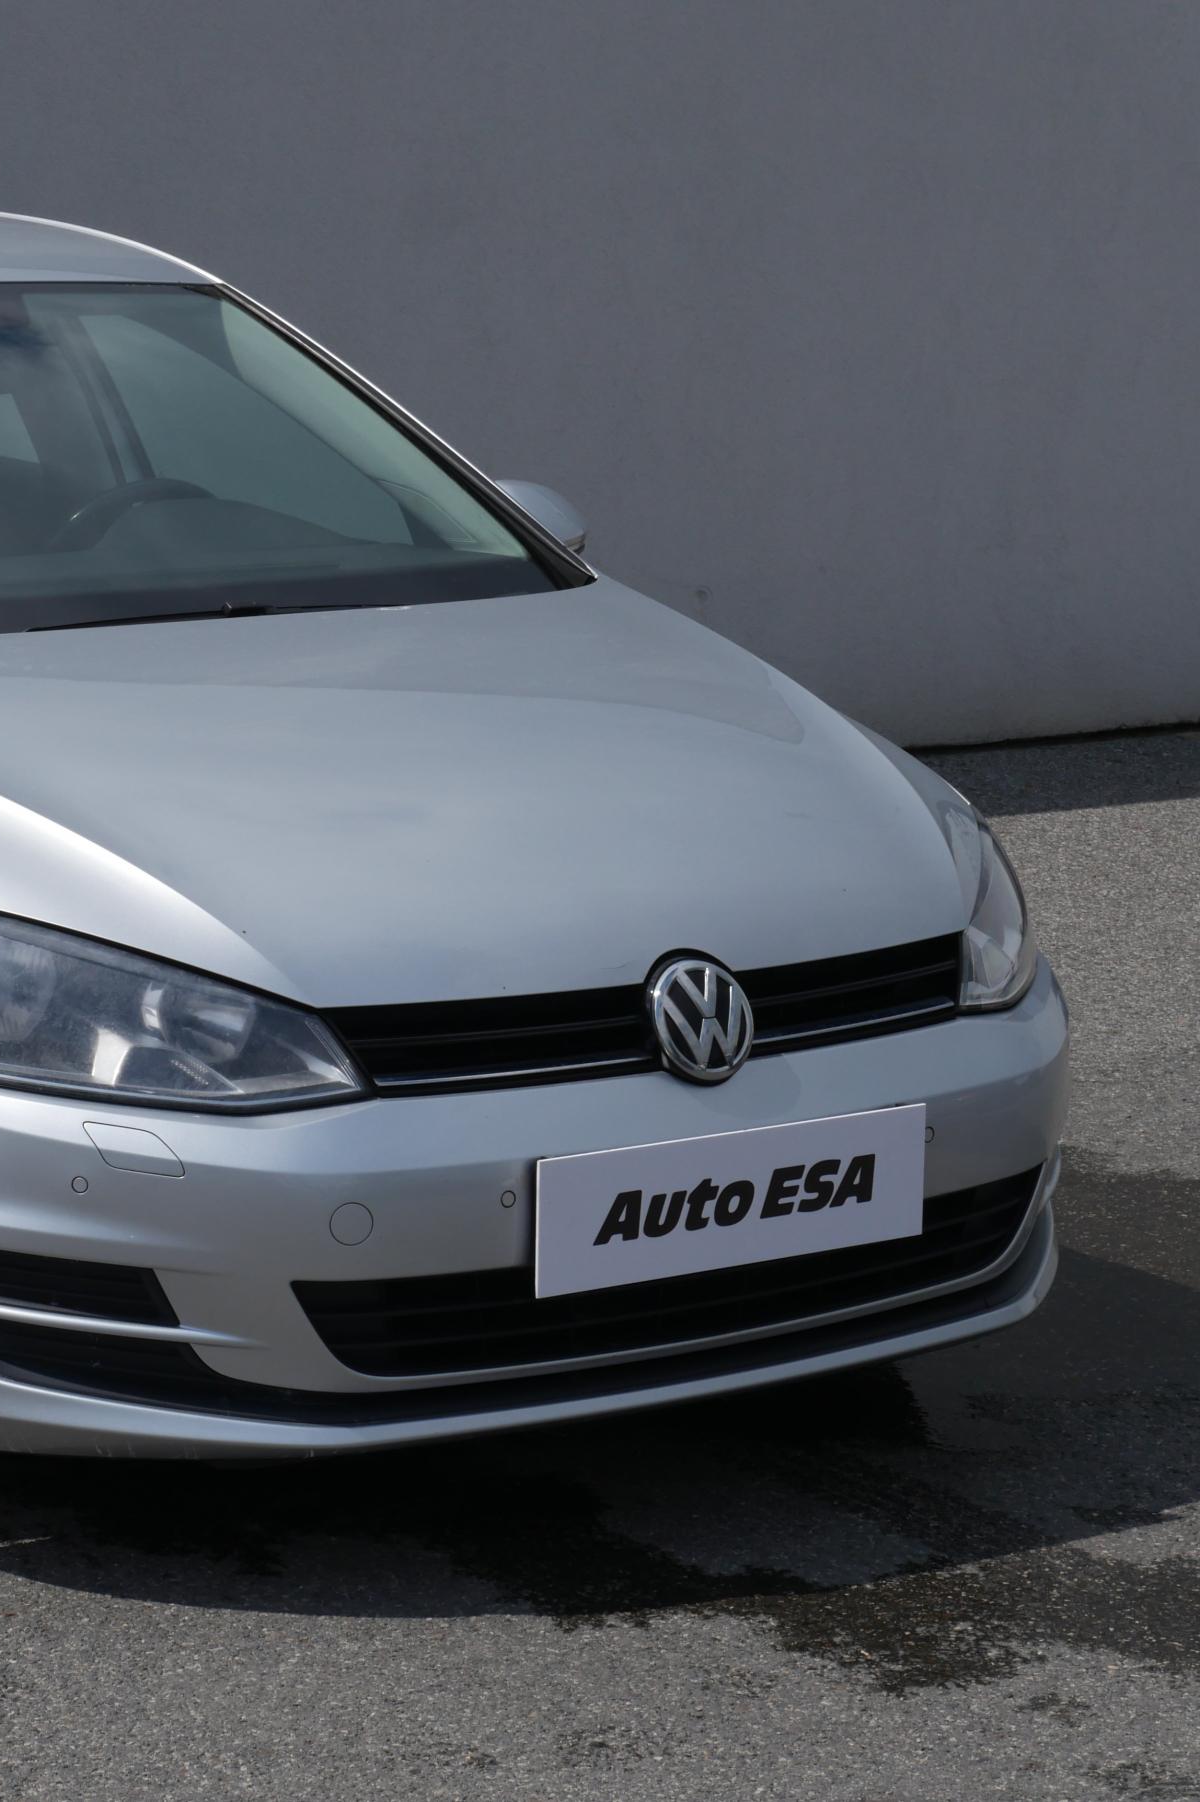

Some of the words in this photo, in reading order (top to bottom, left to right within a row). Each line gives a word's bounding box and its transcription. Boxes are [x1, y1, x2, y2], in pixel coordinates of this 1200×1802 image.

[657, 962, 750, 1074] VW
[593, 1178, 755, 1246] Auto
[759, 1153, 876, 1219] ESA
